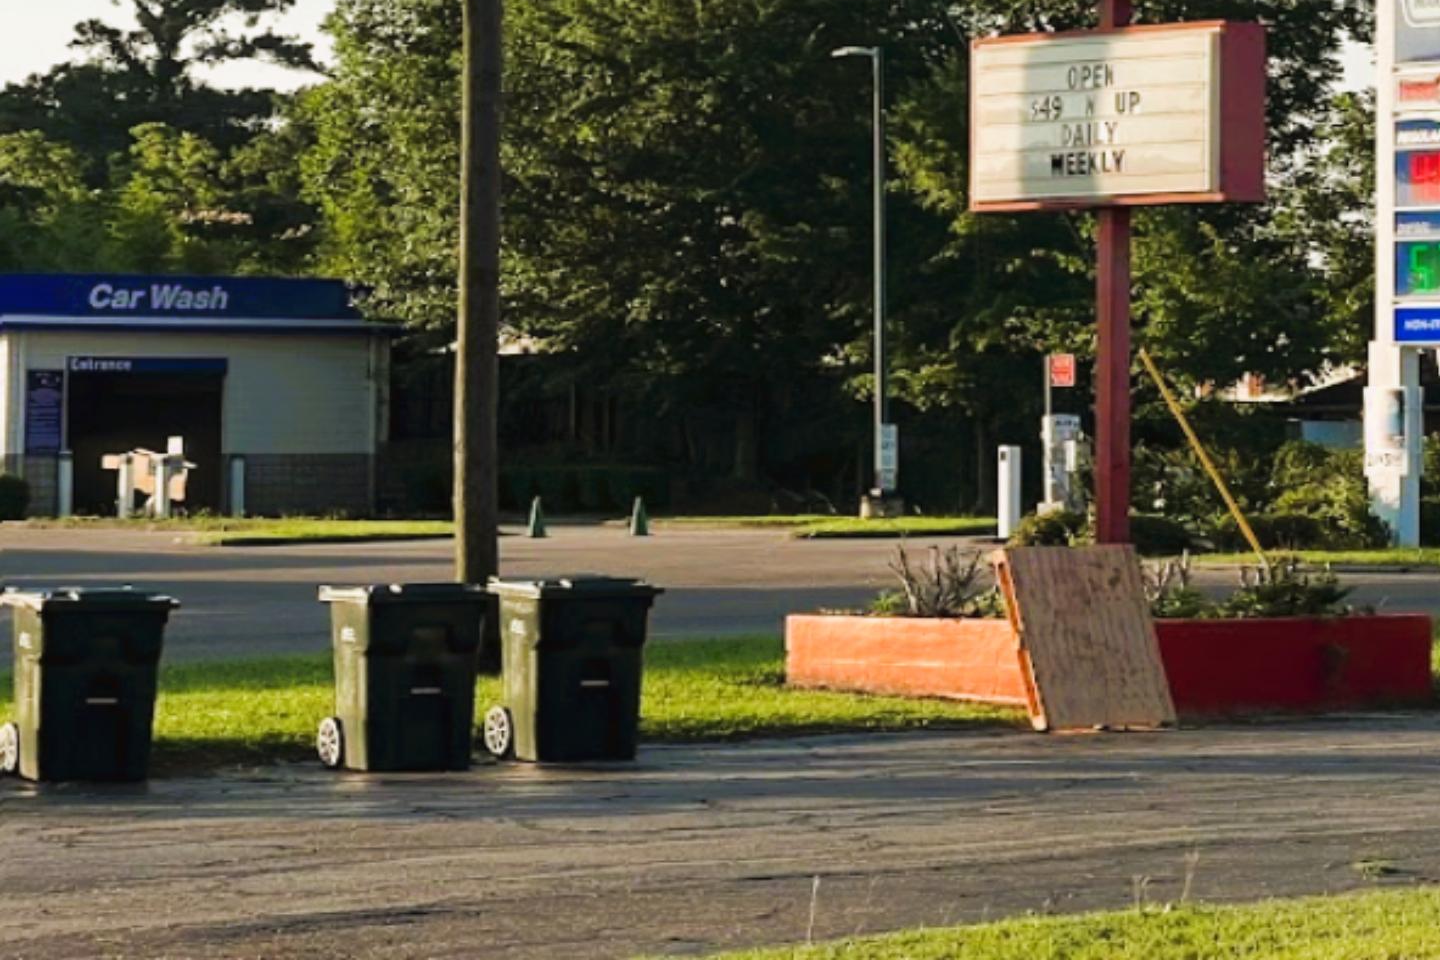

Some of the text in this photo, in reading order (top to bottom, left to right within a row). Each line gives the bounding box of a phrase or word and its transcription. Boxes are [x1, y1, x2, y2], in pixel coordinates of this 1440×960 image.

[1067, 64, 1114, 90] OPEN
[1114, 91, 1141, 114] UP
[1061, 121, 1118, 147] DAILY
[1051, 149, 1125, 176] WEEKLY
[89, 284, 229, 310] Car Wash
[70, 358, 132, 371] Entrance
